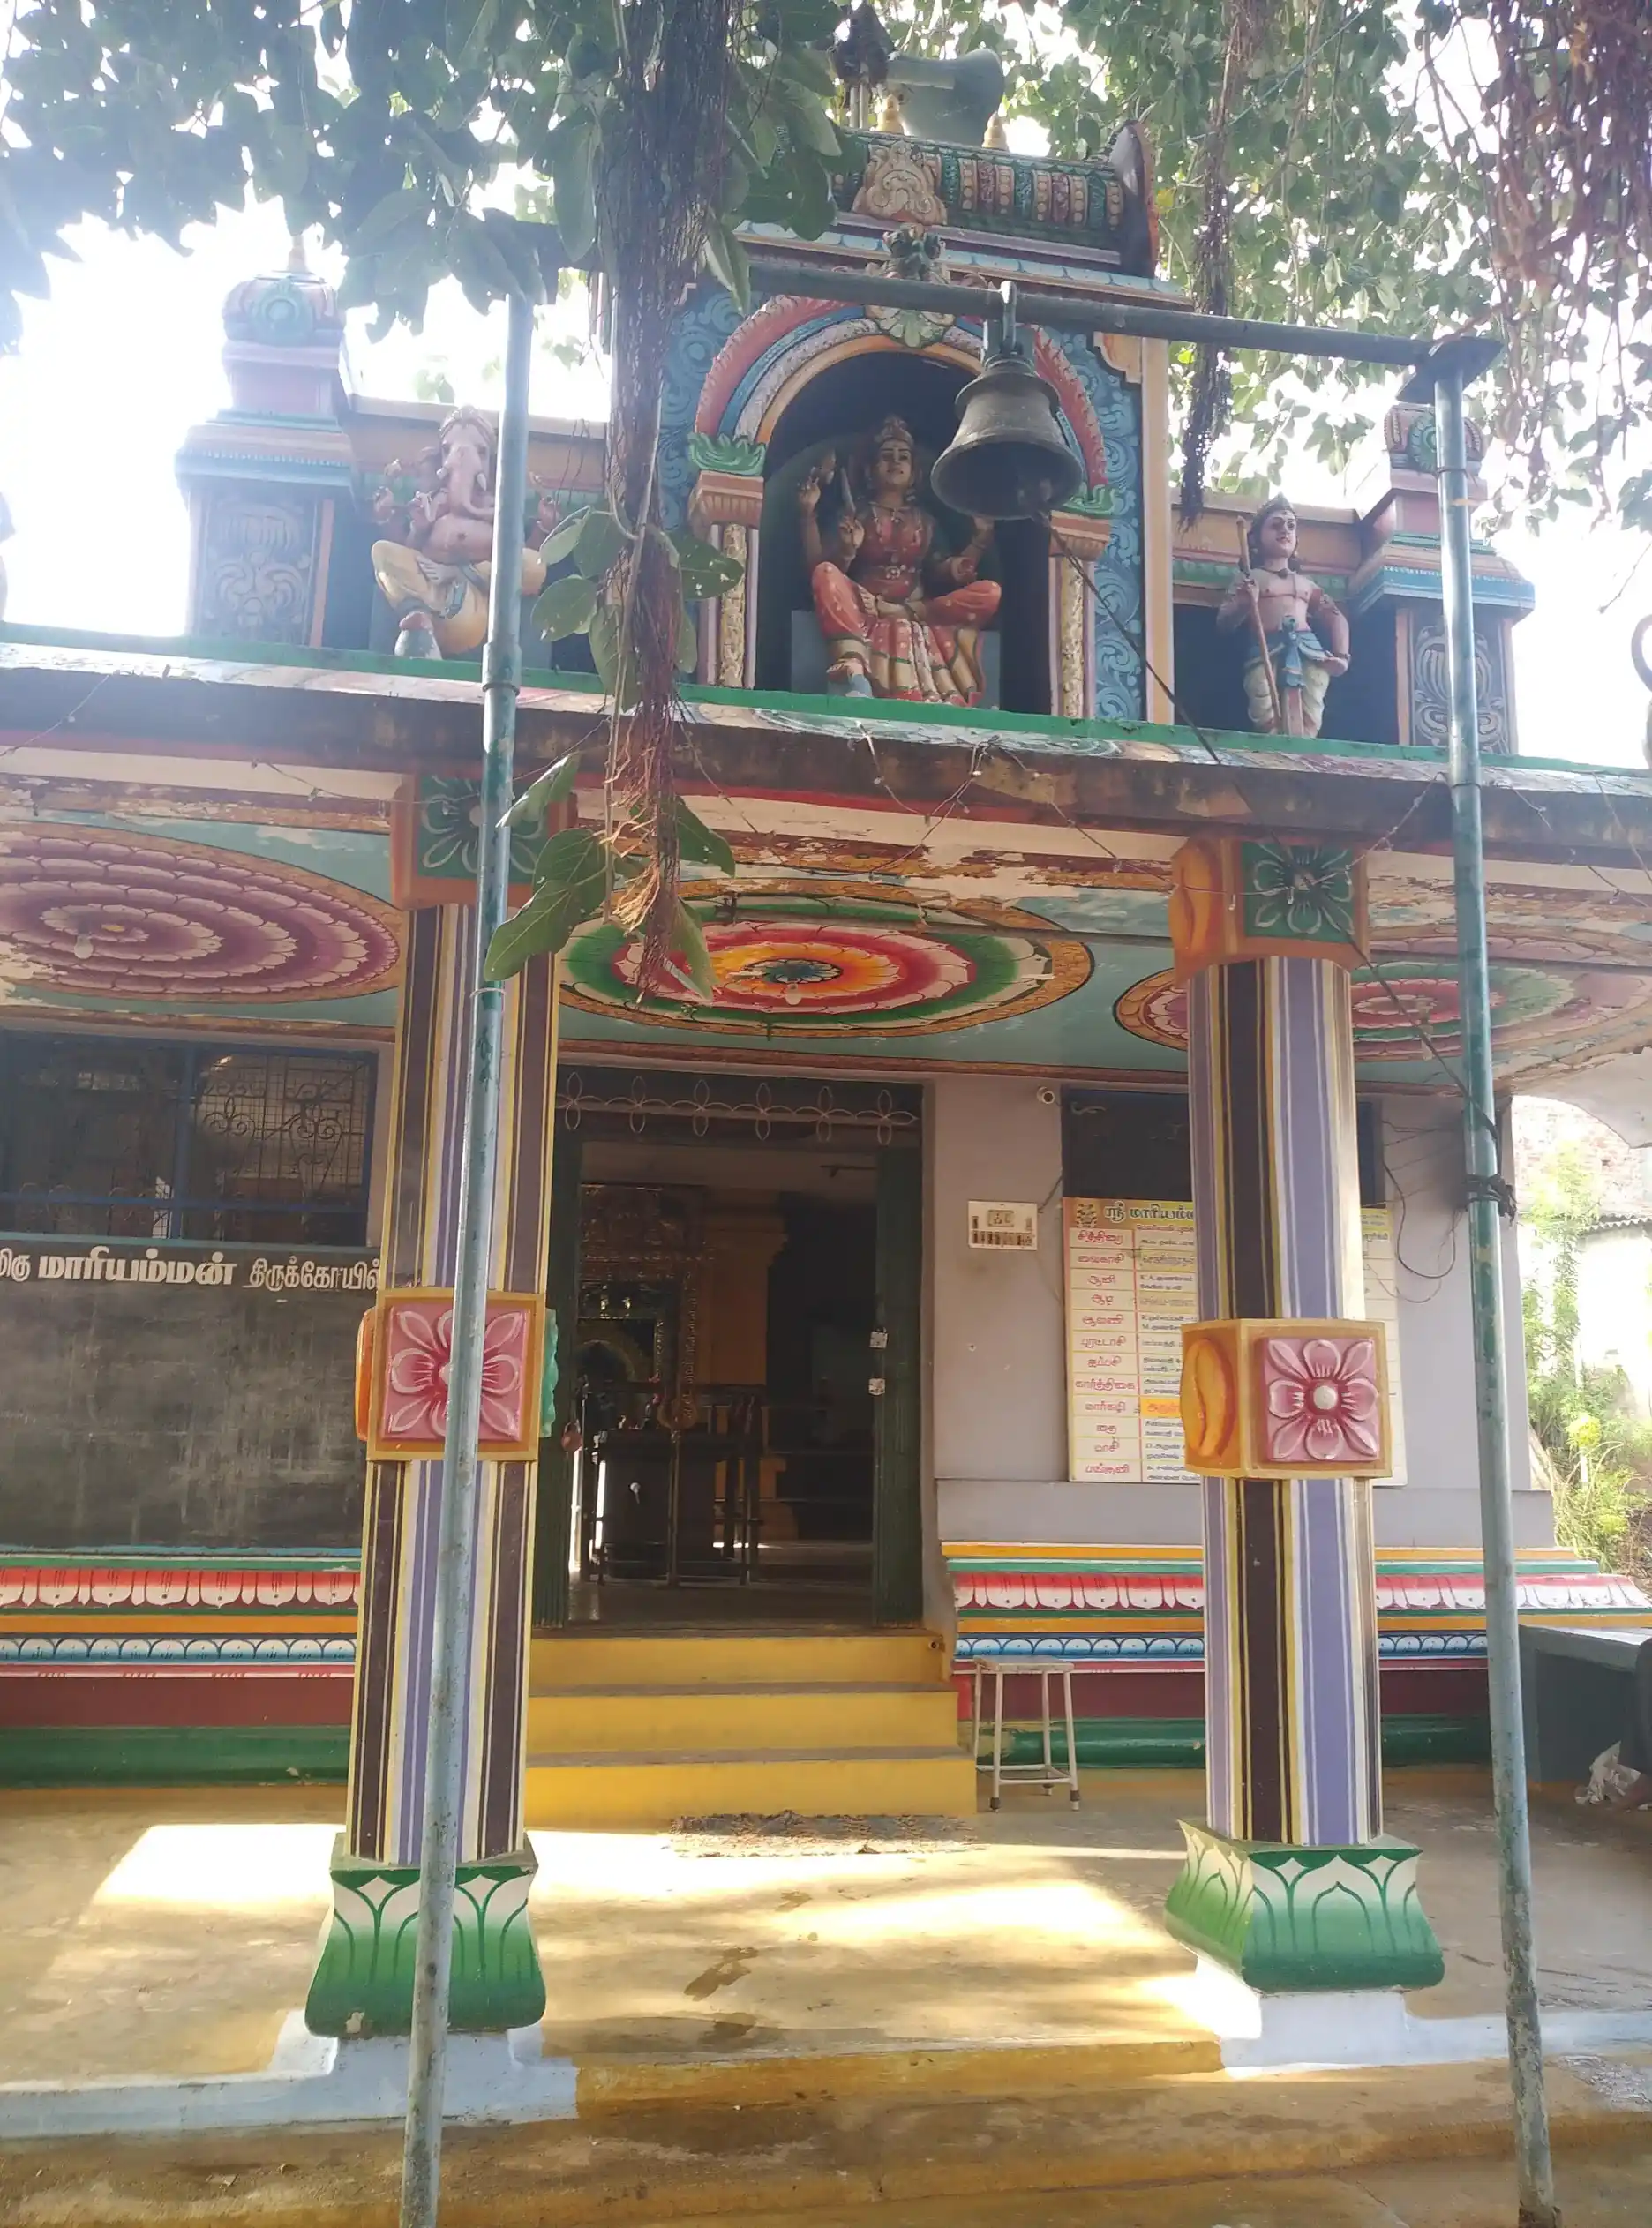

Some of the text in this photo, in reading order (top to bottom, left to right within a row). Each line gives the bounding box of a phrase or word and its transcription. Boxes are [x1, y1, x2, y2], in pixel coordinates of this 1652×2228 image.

[1105, 1201, 1125, 1223] ஸ்ரீ
[1078, 1229, 1124, 1245] சித்திரை
[1078, 1252, 1125, 1264] வைகாசி
[38, 1245, 237, 1286] மாரியம்மன்
[1087, 1274, 1116, 1287] ஆனி
[1091, 1294, 1115, 1306] ஆடி
[1082, 1314, 1124, 1327] ஆவணி
[1080, 1335, 1127, 1349] புரட்டாசி
[1087, 1355, 1122, 1368] ஐப்பசி
[1075, 1377, 1136, 1392] கார்த்திகை
[1085, 1400, 1126, 1414] மார்கழி
[1096, 1424, 1118, 1435] தை
[1094, 1437, 1120, 1452] மாசி
[1085, 1462, 1130, 1475] பங்குனி
